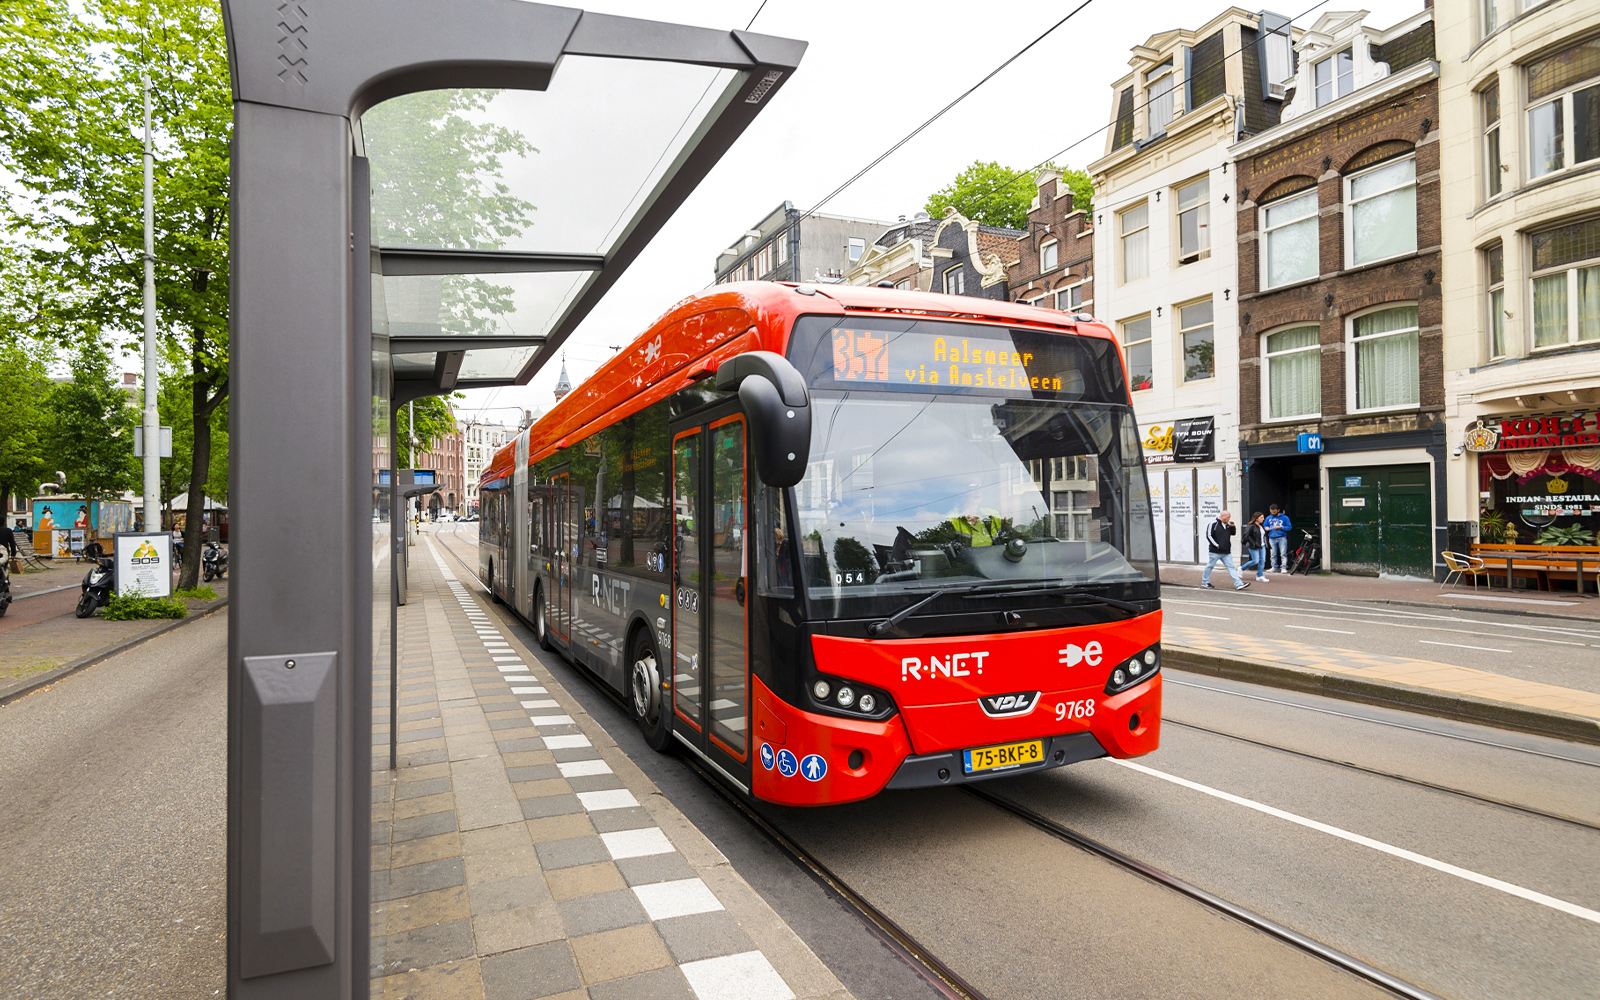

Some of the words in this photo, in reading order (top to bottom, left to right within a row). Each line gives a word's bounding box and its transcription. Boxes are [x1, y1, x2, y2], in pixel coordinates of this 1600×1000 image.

[834, 329, 888, 380] 357
[934, 337, 1033, 367] Aalsmeer
[905, 364, 939, 384] via
[949, 364, 1061, 391] Amstelveen
[1499, 436, 1561, 450] INDIAN
[1564, 432, 1600, 446] RES
[658, 630, 671, 649] 9768
[987, 695, 1029, 711] VDL
[1055, 698, 1095, 722] 9768
[976, 744, 1038, 768] 75-BKF-8
